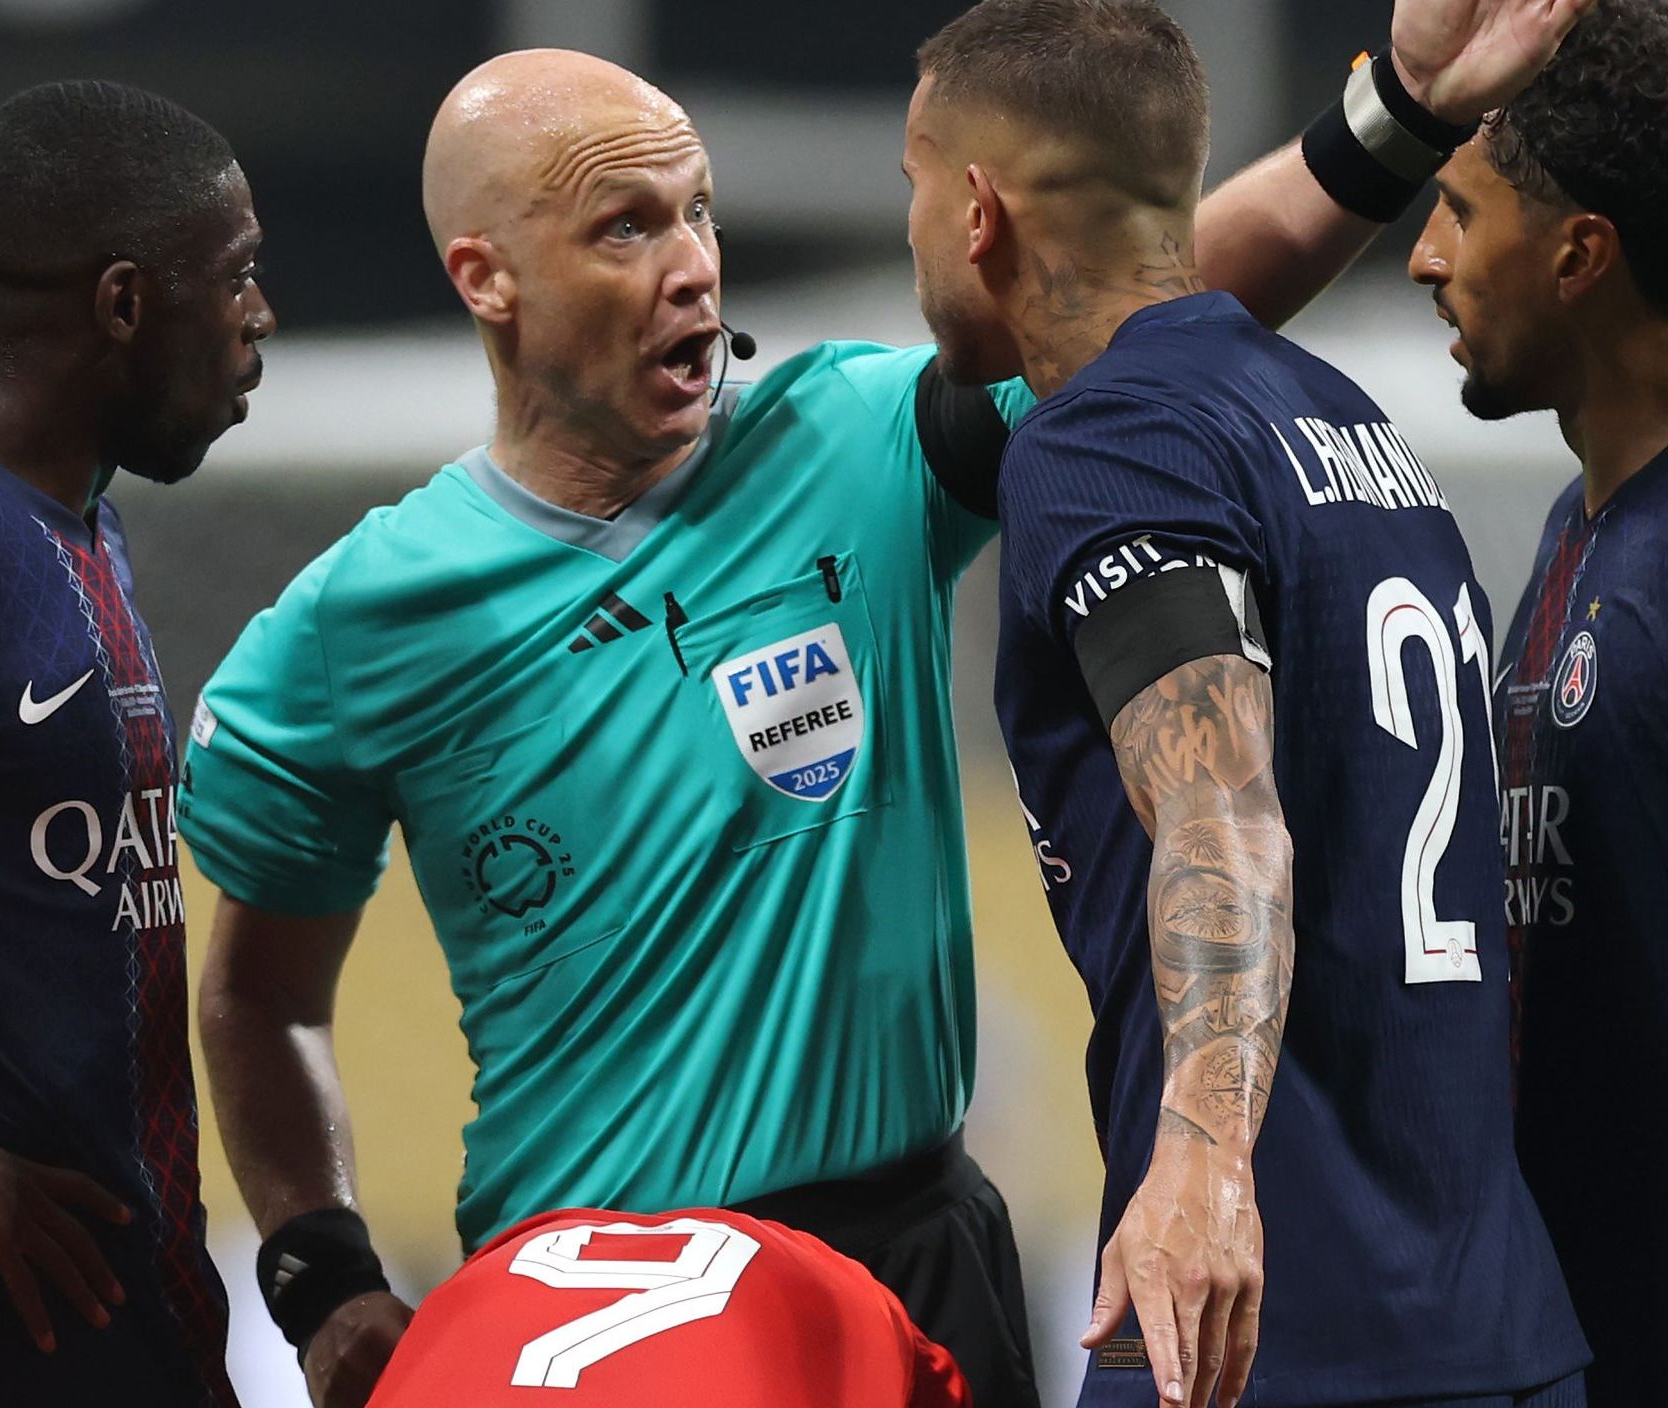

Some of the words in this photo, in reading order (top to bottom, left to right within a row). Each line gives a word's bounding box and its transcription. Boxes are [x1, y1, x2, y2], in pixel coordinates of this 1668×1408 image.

[1064, 534, 1162, 617] VISIT
[727, 641, 840, 708] FIFA
[749, 699, 854, 753] REFEREE
[791, 760, 841, 792] 2025
[1366, 576, 1500, 984] 21
[461, 815, 516, 859] WORLD
[525, 818, 562, 845] CUP
[558, 852, 576, 877] 25
[523, 919, 547, 937] FIFA
